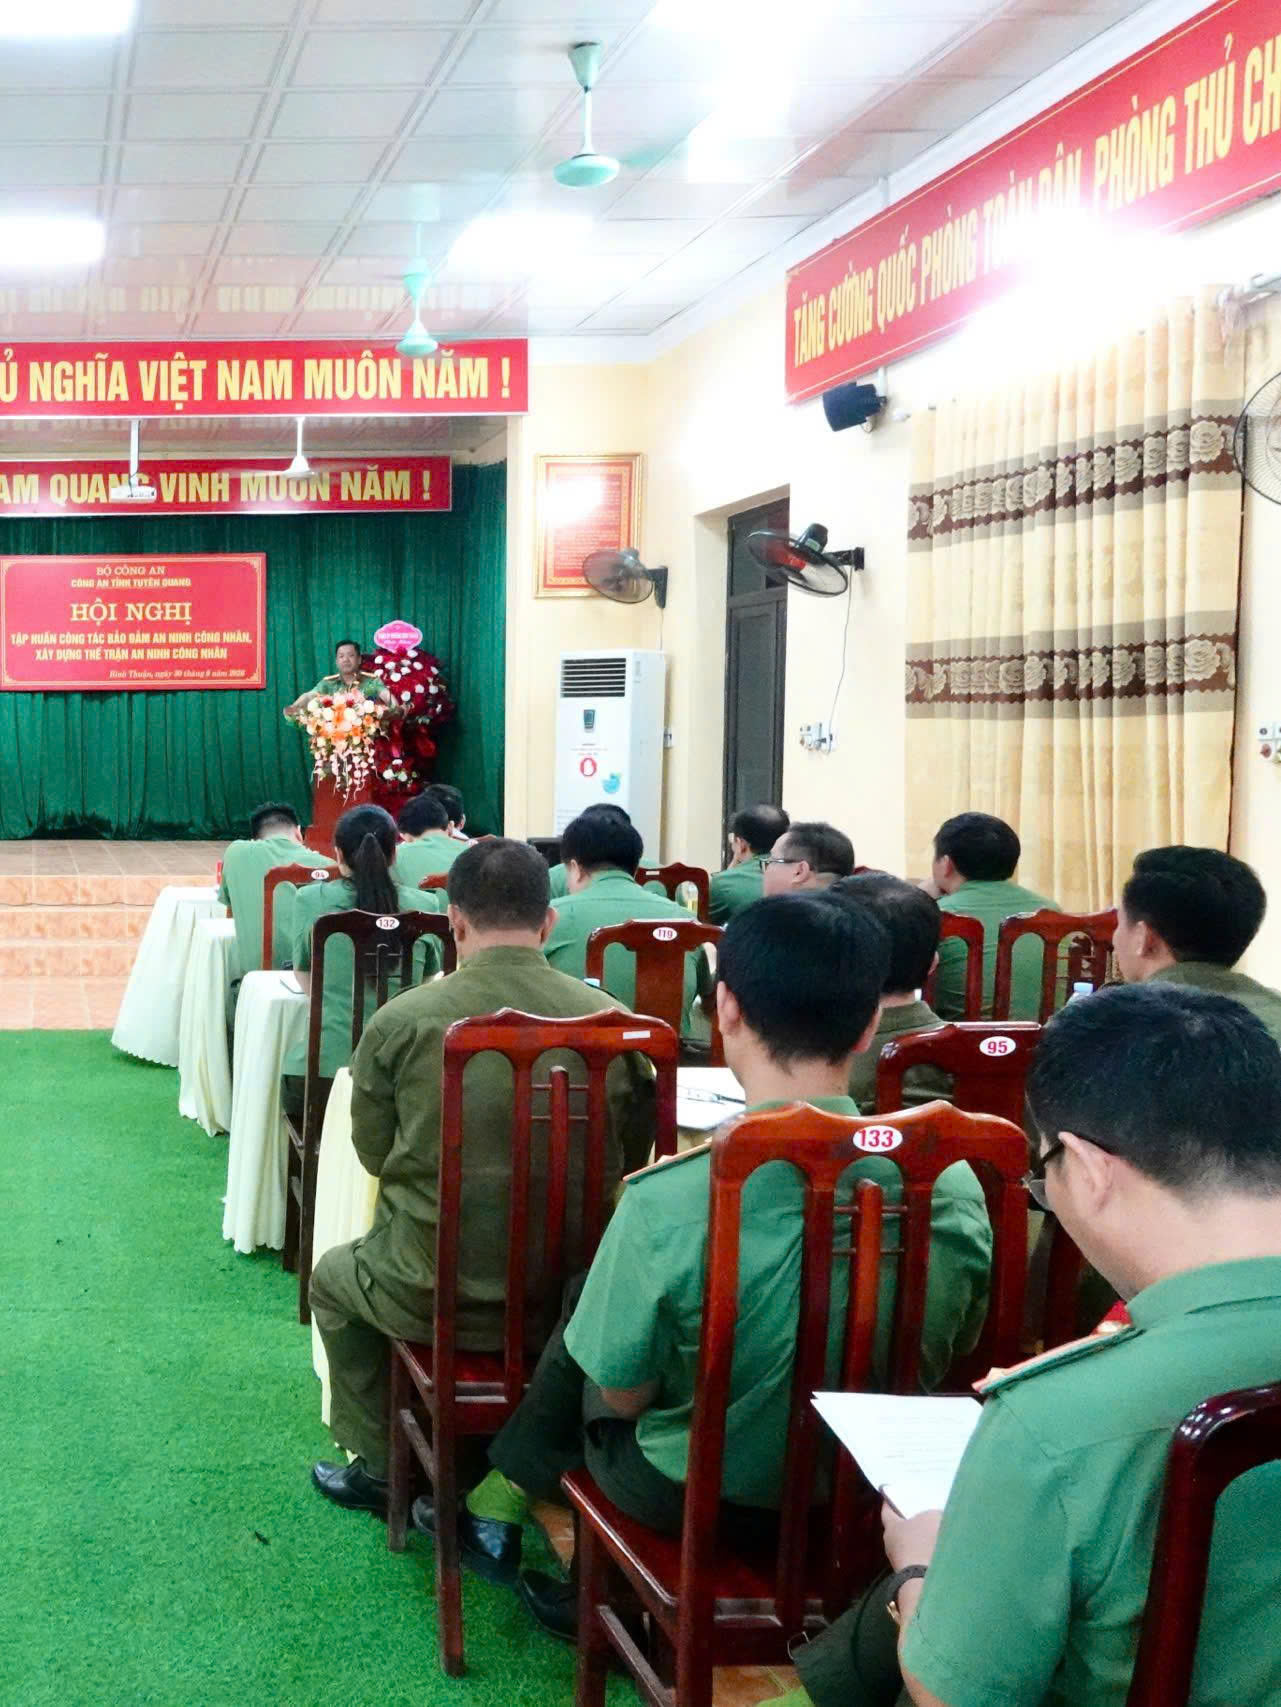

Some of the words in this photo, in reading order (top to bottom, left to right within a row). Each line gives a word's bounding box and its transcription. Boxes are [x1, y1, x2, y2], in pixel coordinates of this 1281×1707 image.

[793, 289, 826, 368] TĂNG
[828, 260, 874, 351] CƯỜNG
[877, 224, 917, 333] QUỐC
[920, 204, 977, 305] PHÒNG
[1093, 95, 1176, 213] PHÒNG
[1184, 32, 1236, 175] THỦ
[30, 352, 129, 401] NGHĨA
[139, 351, 207, 410] VIỆT
[218, 359, 292, 400] NAM
[304, 350, 401, 400] MUÔN
[413, 349, 488, 399] NĂM
[50, 472, 151, 506] QUAN
[160, 472, 230, 502] VINH
[341, 464, 410, 500] NĂM
[149, 566, 166, 575] AN
[70, 597, 118, 626] HỘI
[125, 602, 192, 626] NGHỊ
[59, 631, 85, 645] CÔNG
[87, 631, 105, 644] TÁC
[107, 629, 127, 645] BẢO
[152, 632, 166, 644] AN
[168, 632, 192, 643] NINH
[194, 630, 220, 643] CÔNG
[130, 648, 145, 660] AN
[146, 648, 170, 660] NINH
[172, 646, 198, 659] CÔNG
[200, 646, 228, 659] NHÂN
[987, 1041, 1008, 1054] 95
[859, 1129, 894, 1147] 133
